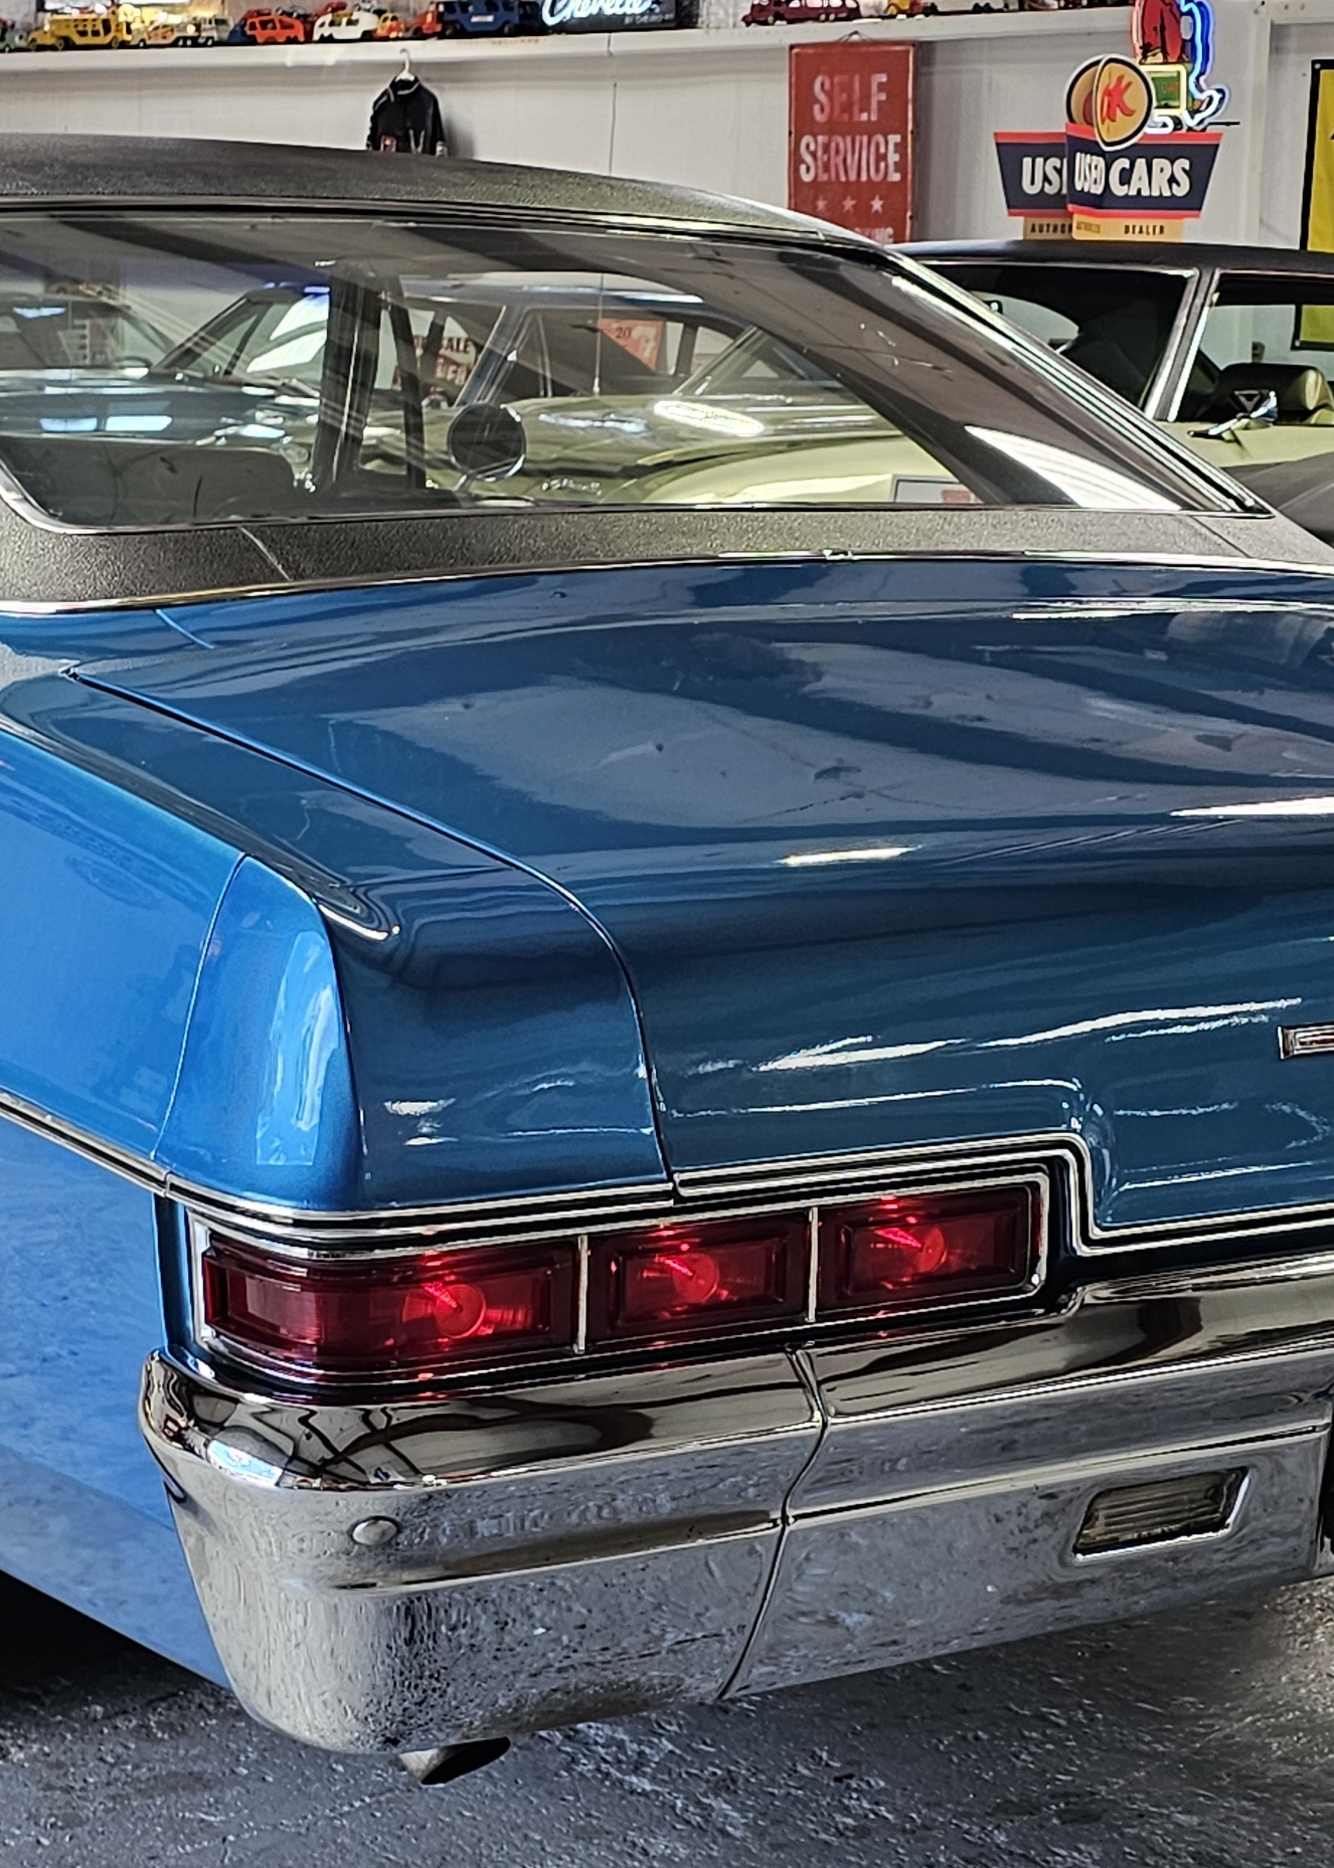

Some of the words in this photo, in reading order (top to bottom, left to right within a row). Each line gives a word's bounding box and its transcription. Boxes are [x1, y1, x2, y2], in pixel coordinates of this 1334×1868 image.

[813, 73, 887, 123] SELF
[799, 134, 902, 182] SERVICE
[1074, 151, 1106, 195] USED
[1108, 157, 1190, 197] CARS
[1124, 224, 1165, 235] DEALER
